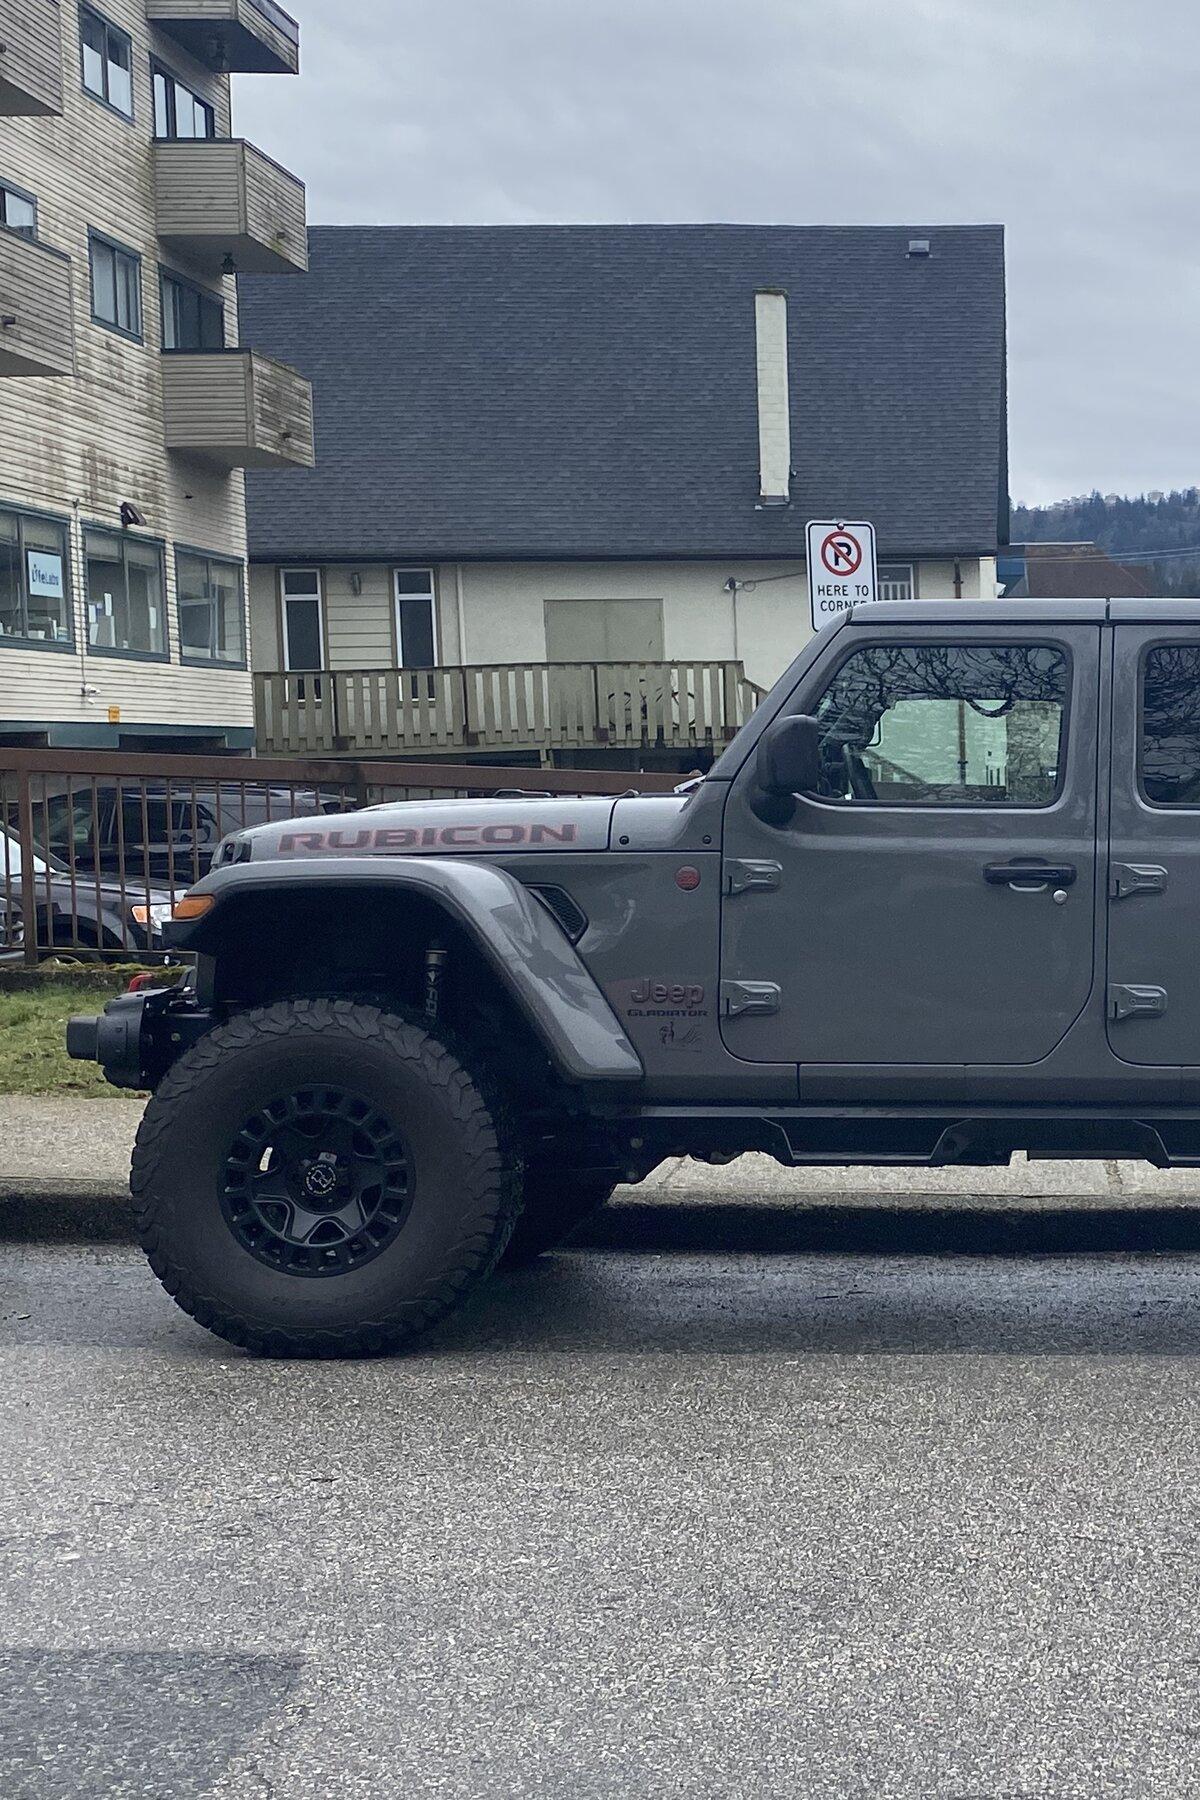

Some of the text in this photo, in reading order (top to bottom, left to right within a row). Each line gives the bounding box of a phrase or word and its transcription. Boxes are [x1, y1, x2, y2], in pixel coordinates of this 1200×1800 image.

[817, 585, 869, 596] HERE TO
[279, 824, 577, 852] RUBICON
[631, 978, 704, 1009] Jeep
[627, 1009, 709, 1017] GLADIATOR
